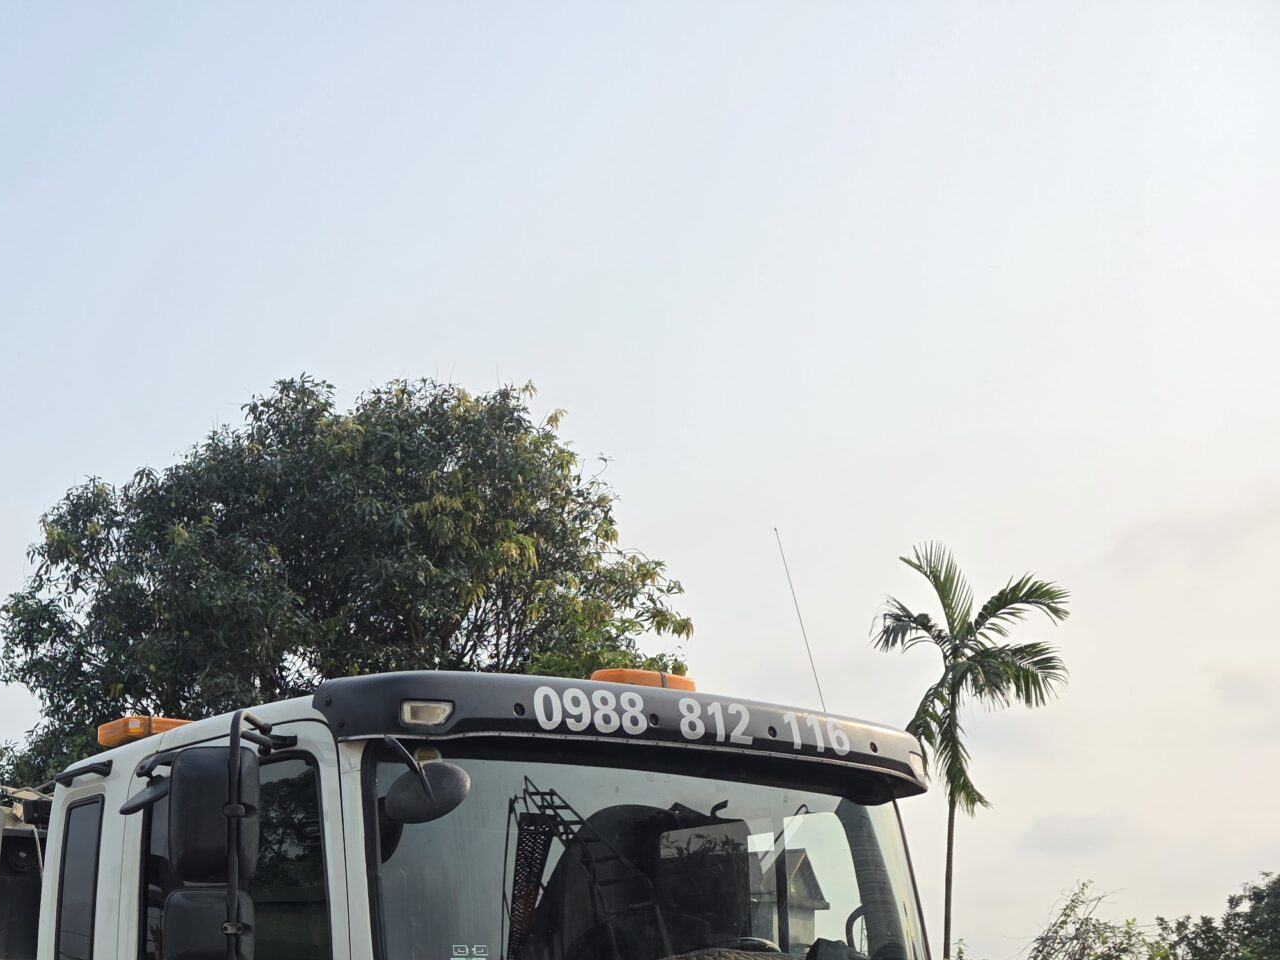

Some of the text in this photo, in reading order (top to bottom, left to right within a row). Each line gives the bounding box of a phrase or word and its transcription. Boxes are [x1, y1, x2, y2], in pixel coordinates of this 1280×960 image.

[533, 685, 851, 756] 0988 812 116
